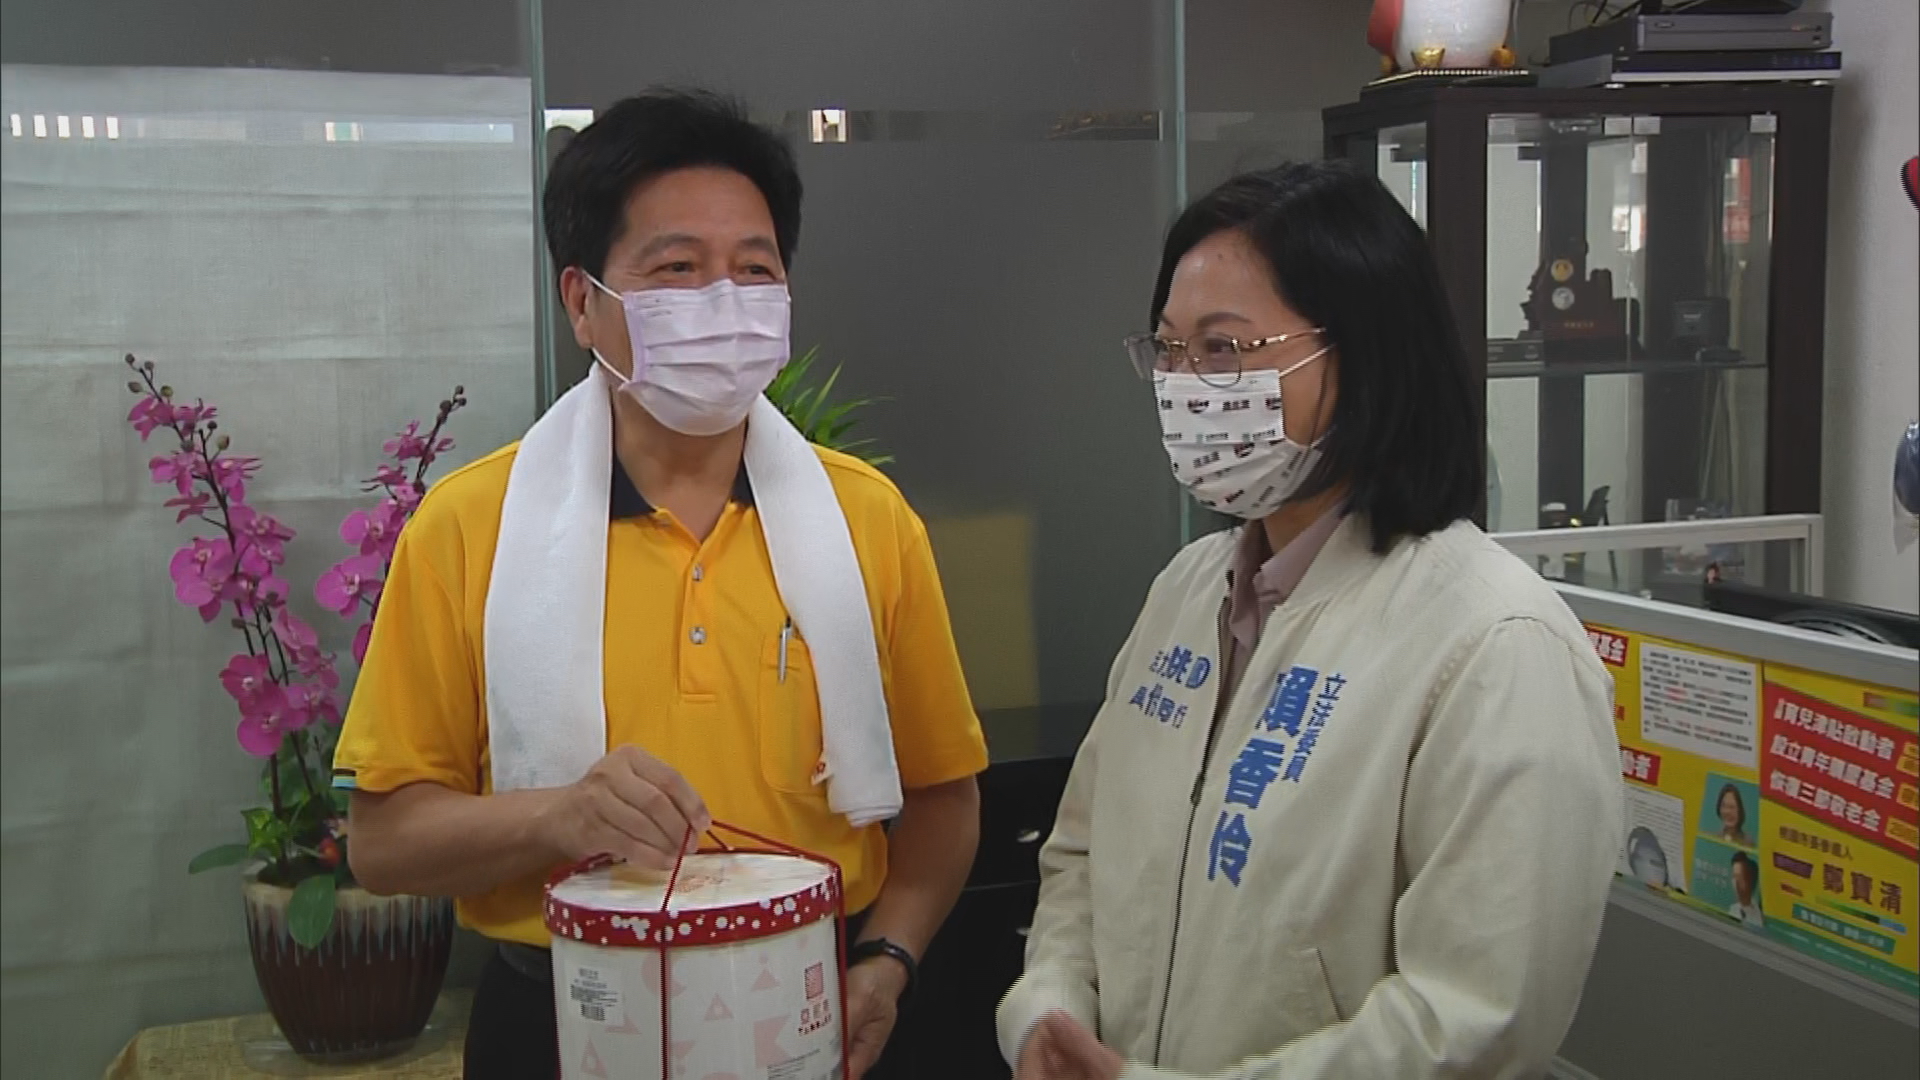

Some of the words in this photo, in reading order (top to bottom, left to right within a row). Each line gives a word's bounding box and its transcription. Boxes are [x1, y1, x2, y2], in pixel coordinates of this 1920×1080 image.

[1207, 666, 1319, 888] 賴香伶
[1282, 673, 1347, 783] 立法委員
[1822, 861, 1903, 915] 鄭寶清
